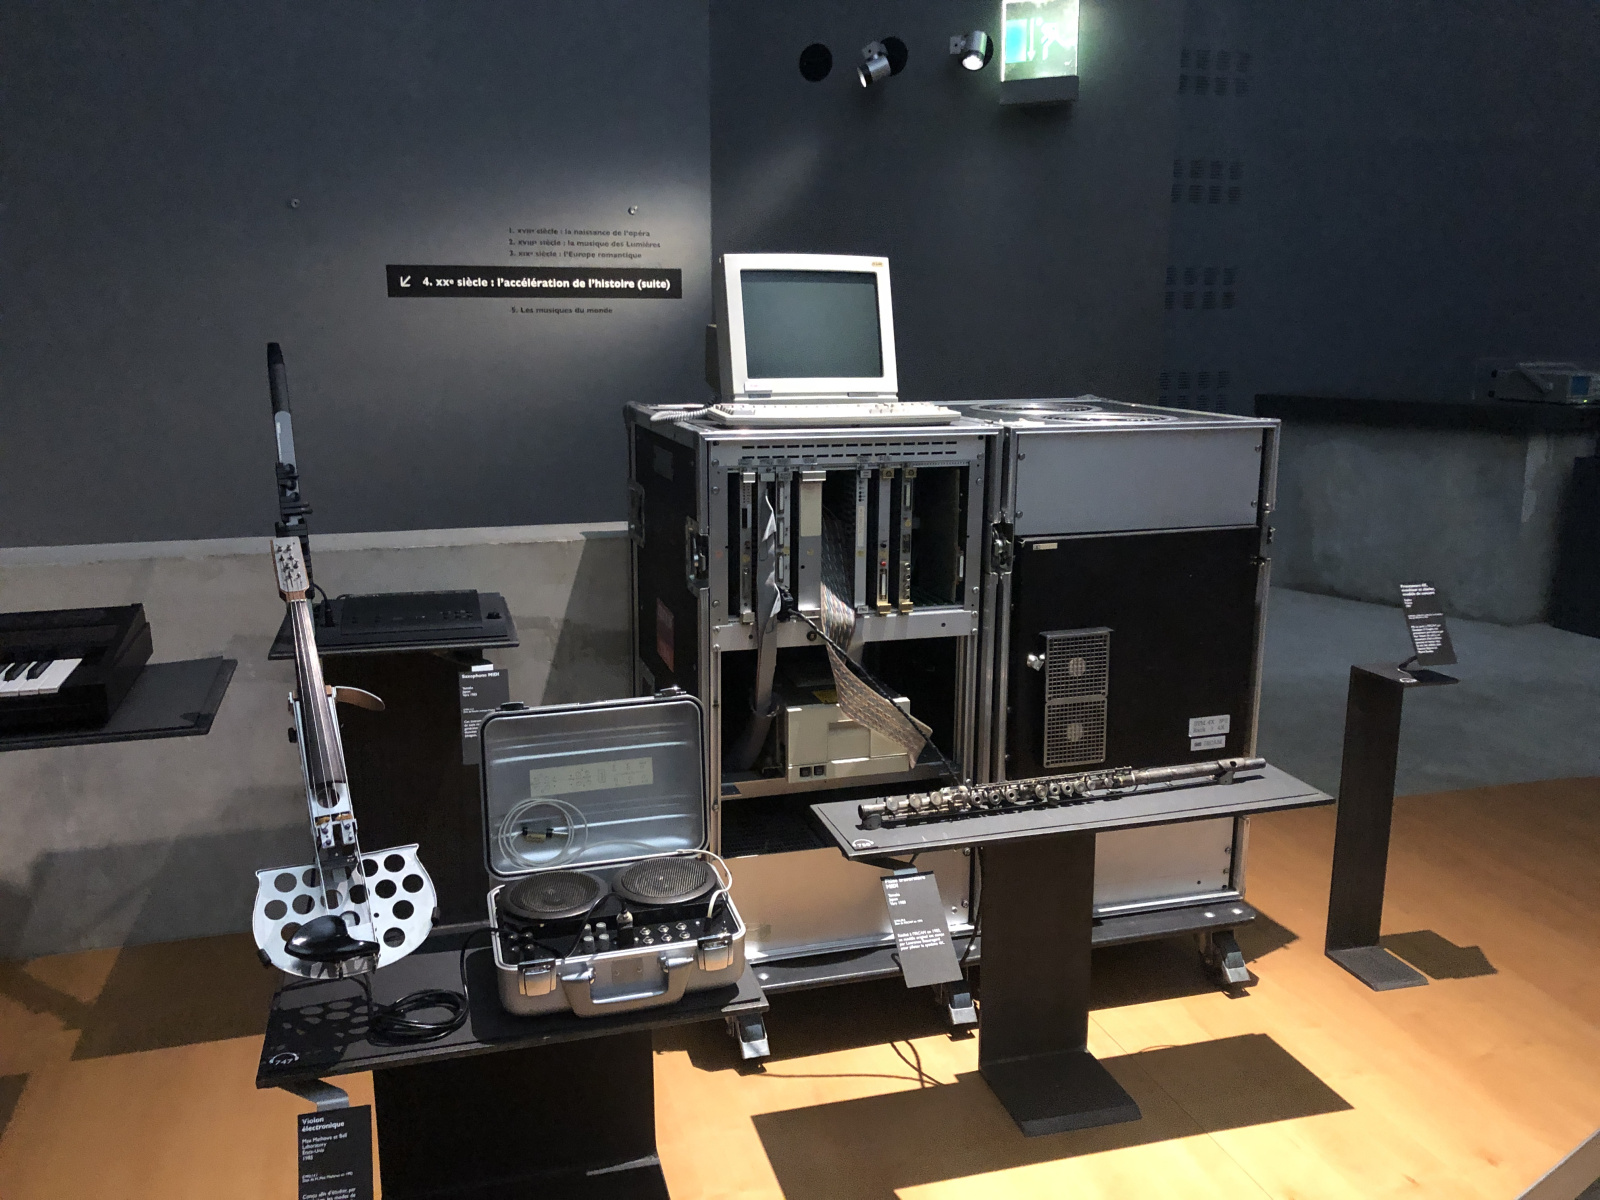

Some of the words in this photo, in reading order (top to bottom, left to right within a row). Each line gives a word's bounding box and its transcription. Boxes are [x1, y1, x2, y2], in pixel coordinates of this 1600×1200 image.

[564, 251, 595, 259] l'Europe
[598, 252, 642, 260] romantique
[423, 277, 433, 286] 4.
[458, 277, 488, 287] siècle
[497, 277, 570, 288] l'accélération
[573, 279, 586, 288] de
[588, 279, 635, 288] l'histoire
[638, 279, 671, 291] (suite)
[302, 1121, 344, 1132] électronique
